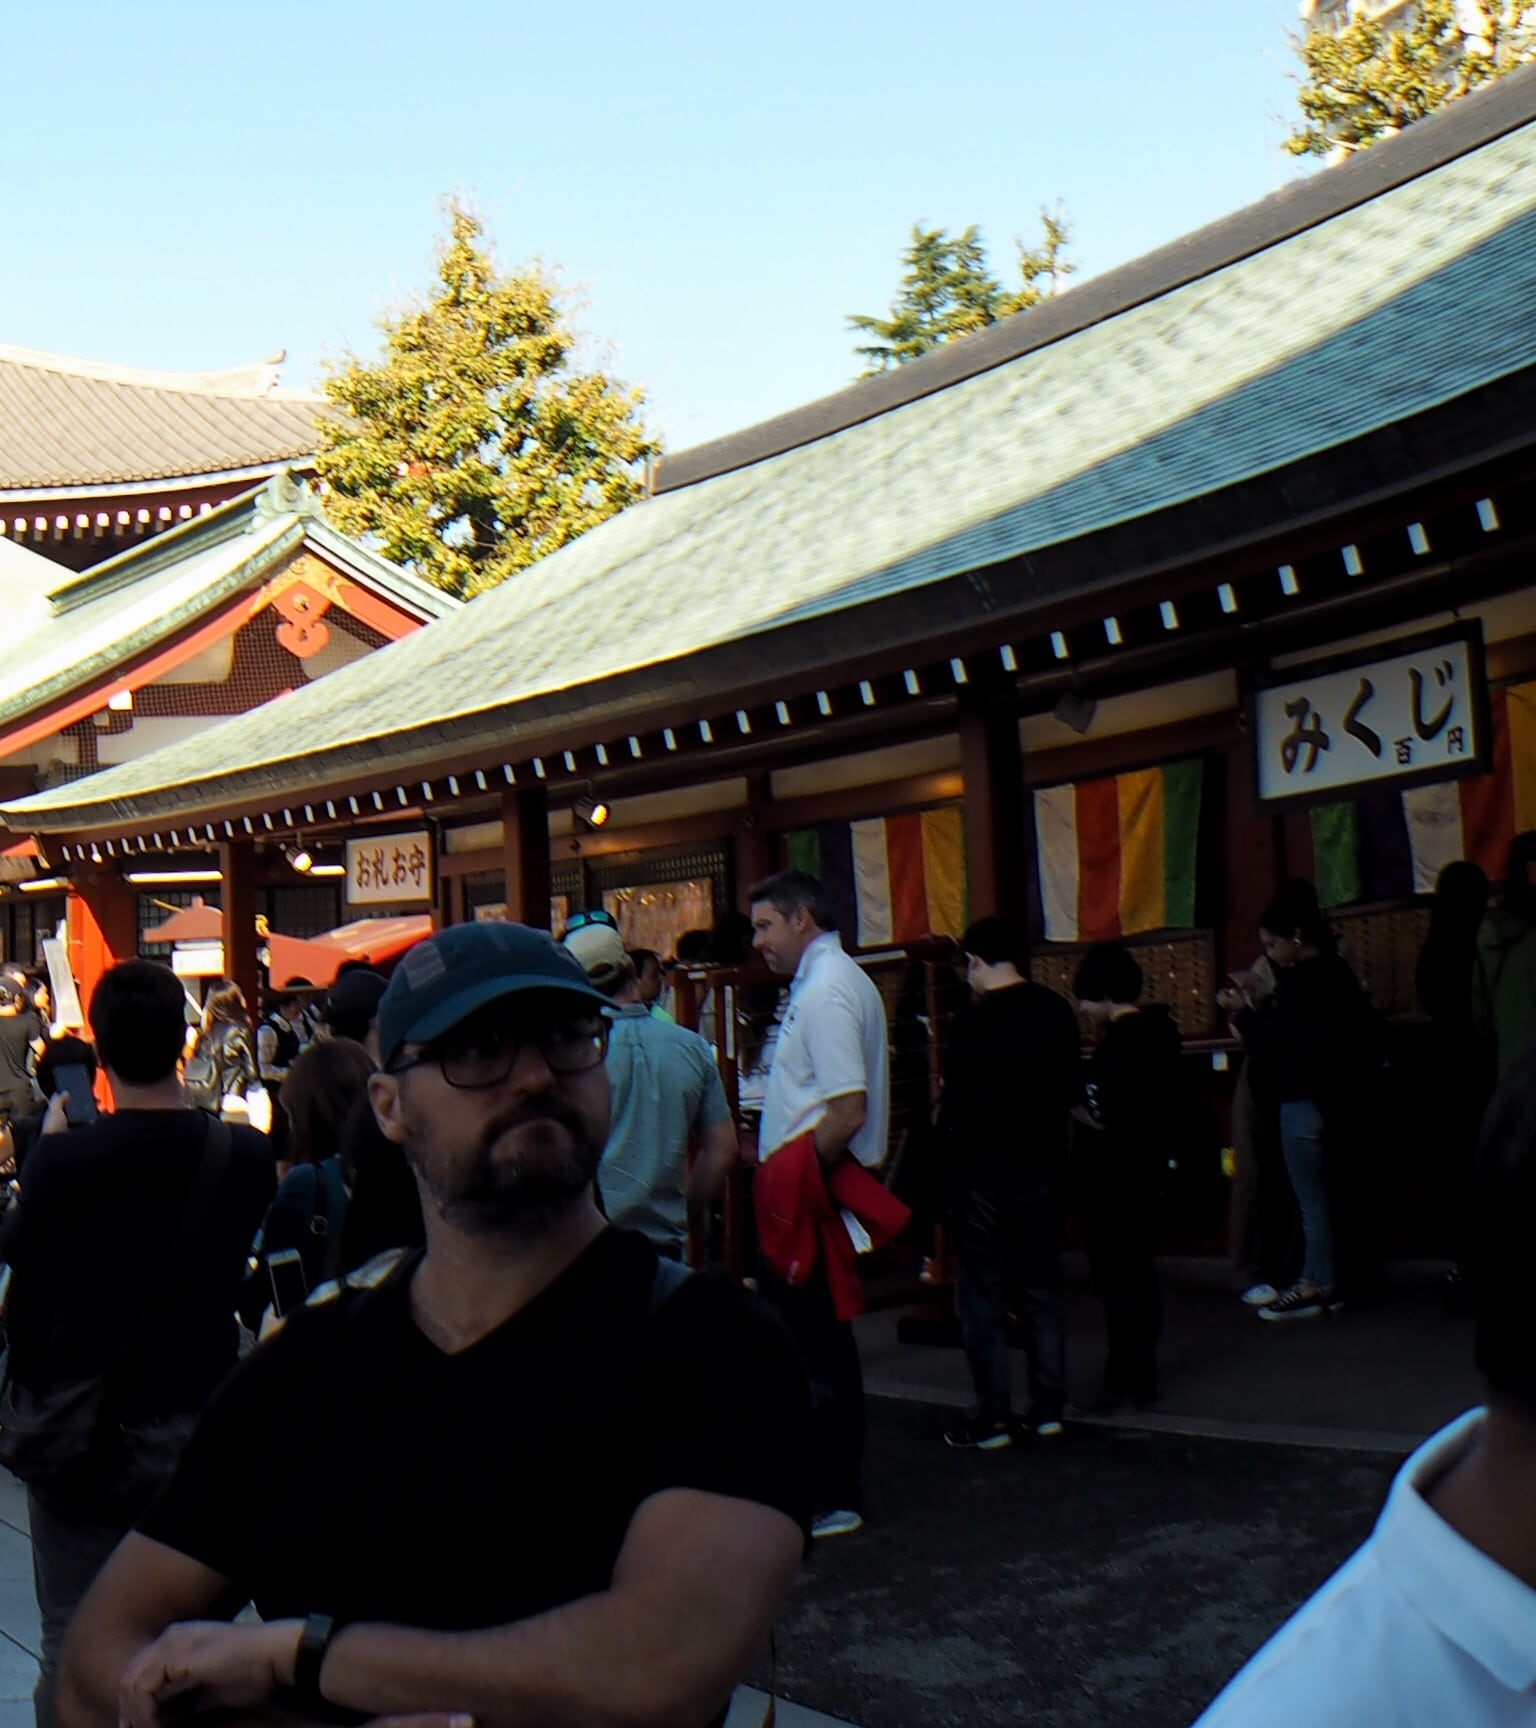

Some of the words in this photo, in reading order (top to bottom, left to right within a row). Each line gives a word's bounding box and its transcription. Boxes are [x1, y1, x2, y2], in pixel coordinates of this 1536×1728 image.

[1281, 659, 1454, 774] みくじ
[356, 843, 427, 890] お札お守
